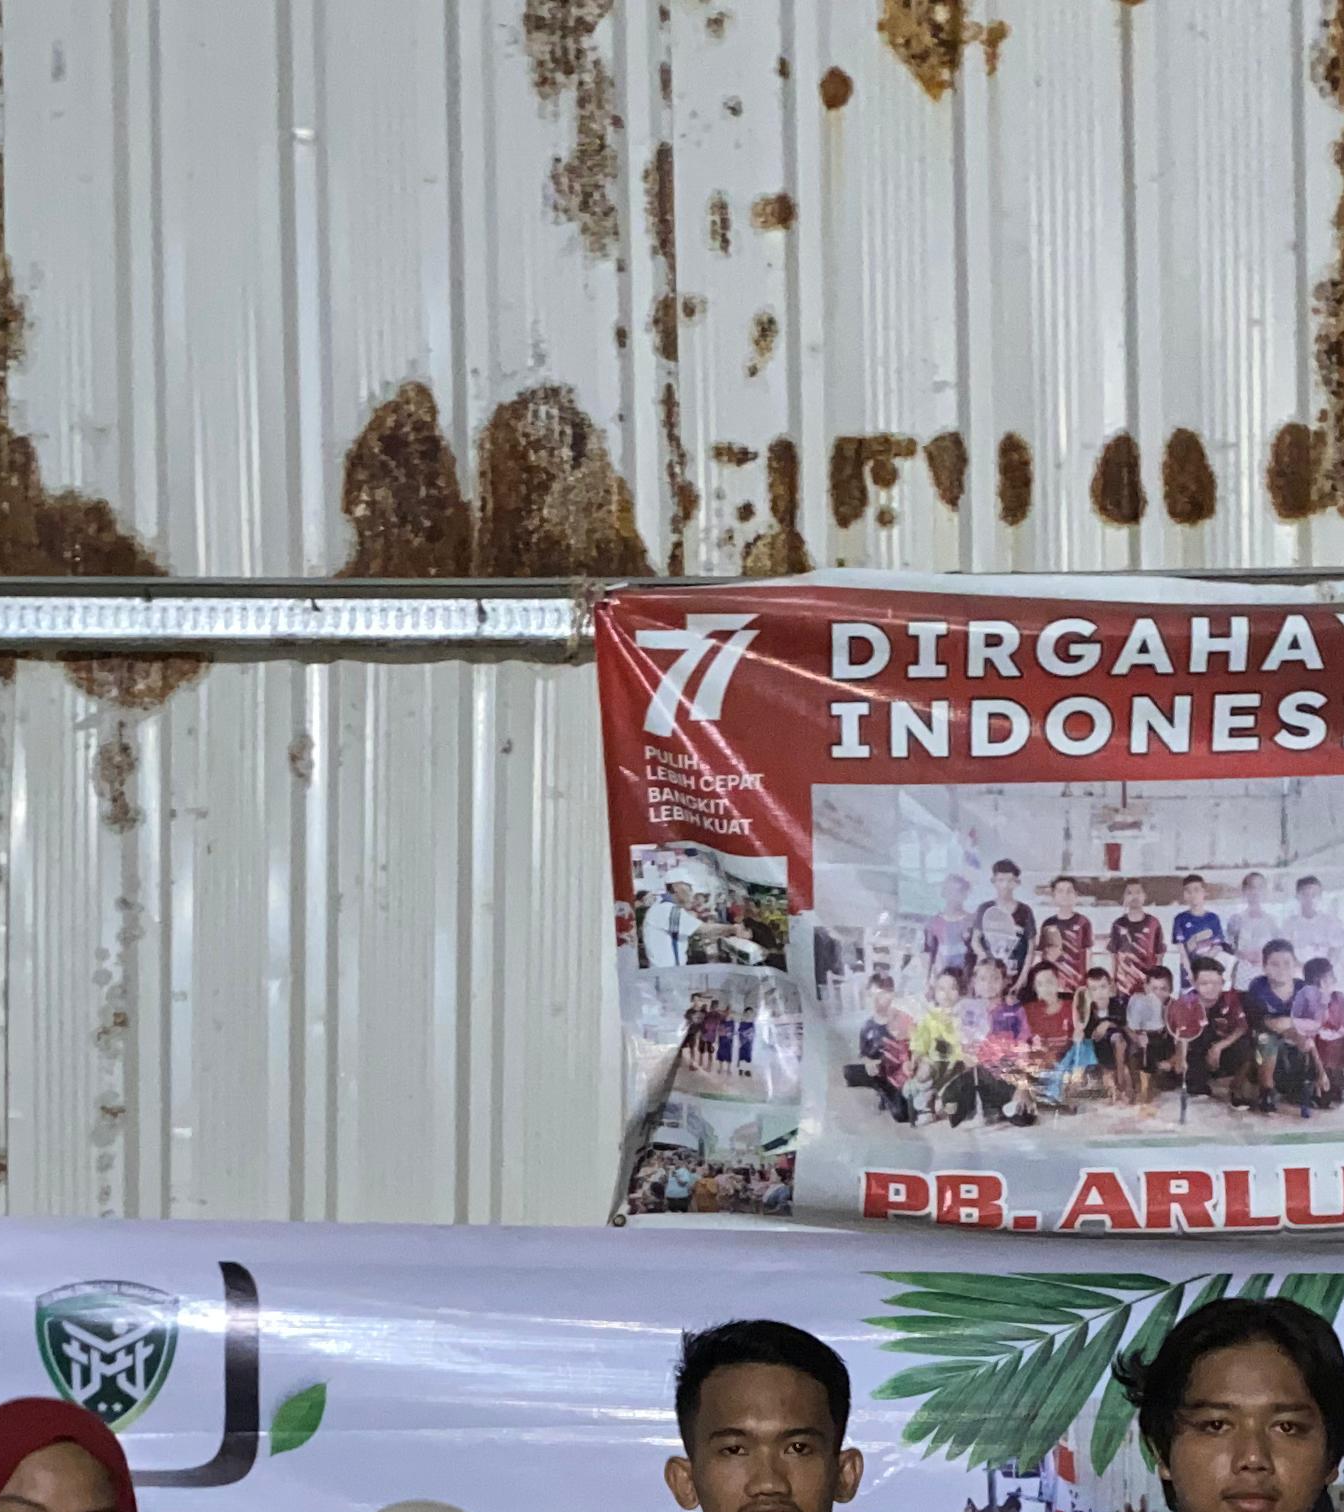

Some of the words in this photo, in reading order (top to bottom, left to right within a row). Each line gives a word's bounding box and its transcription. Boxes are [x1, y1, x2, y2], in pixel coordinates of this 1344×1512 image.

[635, 613, 761, 737] 77
[643, 745, 698, 770] PULIH
[646, 765, 695, 790] LEBIH
[699, 773, 765, 791] CEPAT
[647, 787, 728, 815] BANGKIT
[649, 807, 701, 826] LEBIH
[702, 818, 754, 835] KUAT
[860, 1169, 1042, 1233] PB.
